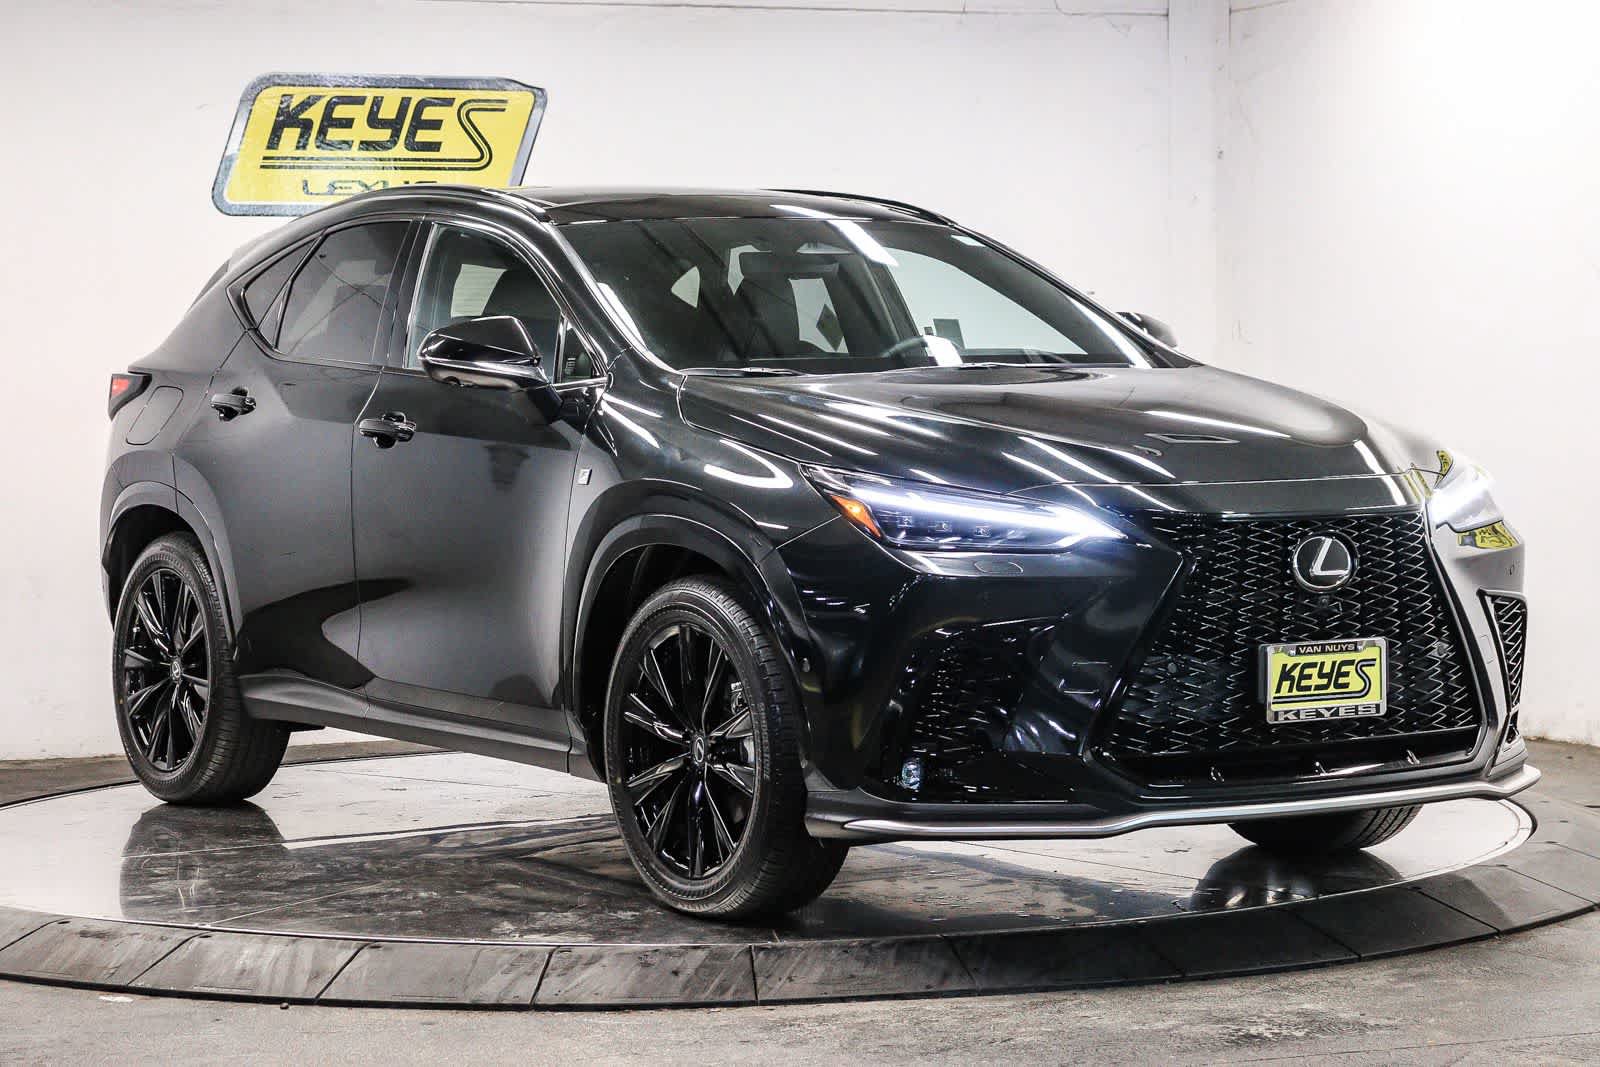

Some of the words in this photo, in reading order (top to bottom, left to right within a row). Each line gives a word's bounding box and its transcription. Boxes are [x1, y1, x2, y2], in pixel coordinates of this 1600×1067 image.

[260, 94, 509, 171] KEYES
[302, 179, 438, 195] LEX
[1298, 645, 1321, 655] VAN
[1325, 643, 1355, 653] NUYS
[1272, 658, 1377, 705] KEYES
[1278, 704, 1377, 721] KEYES
